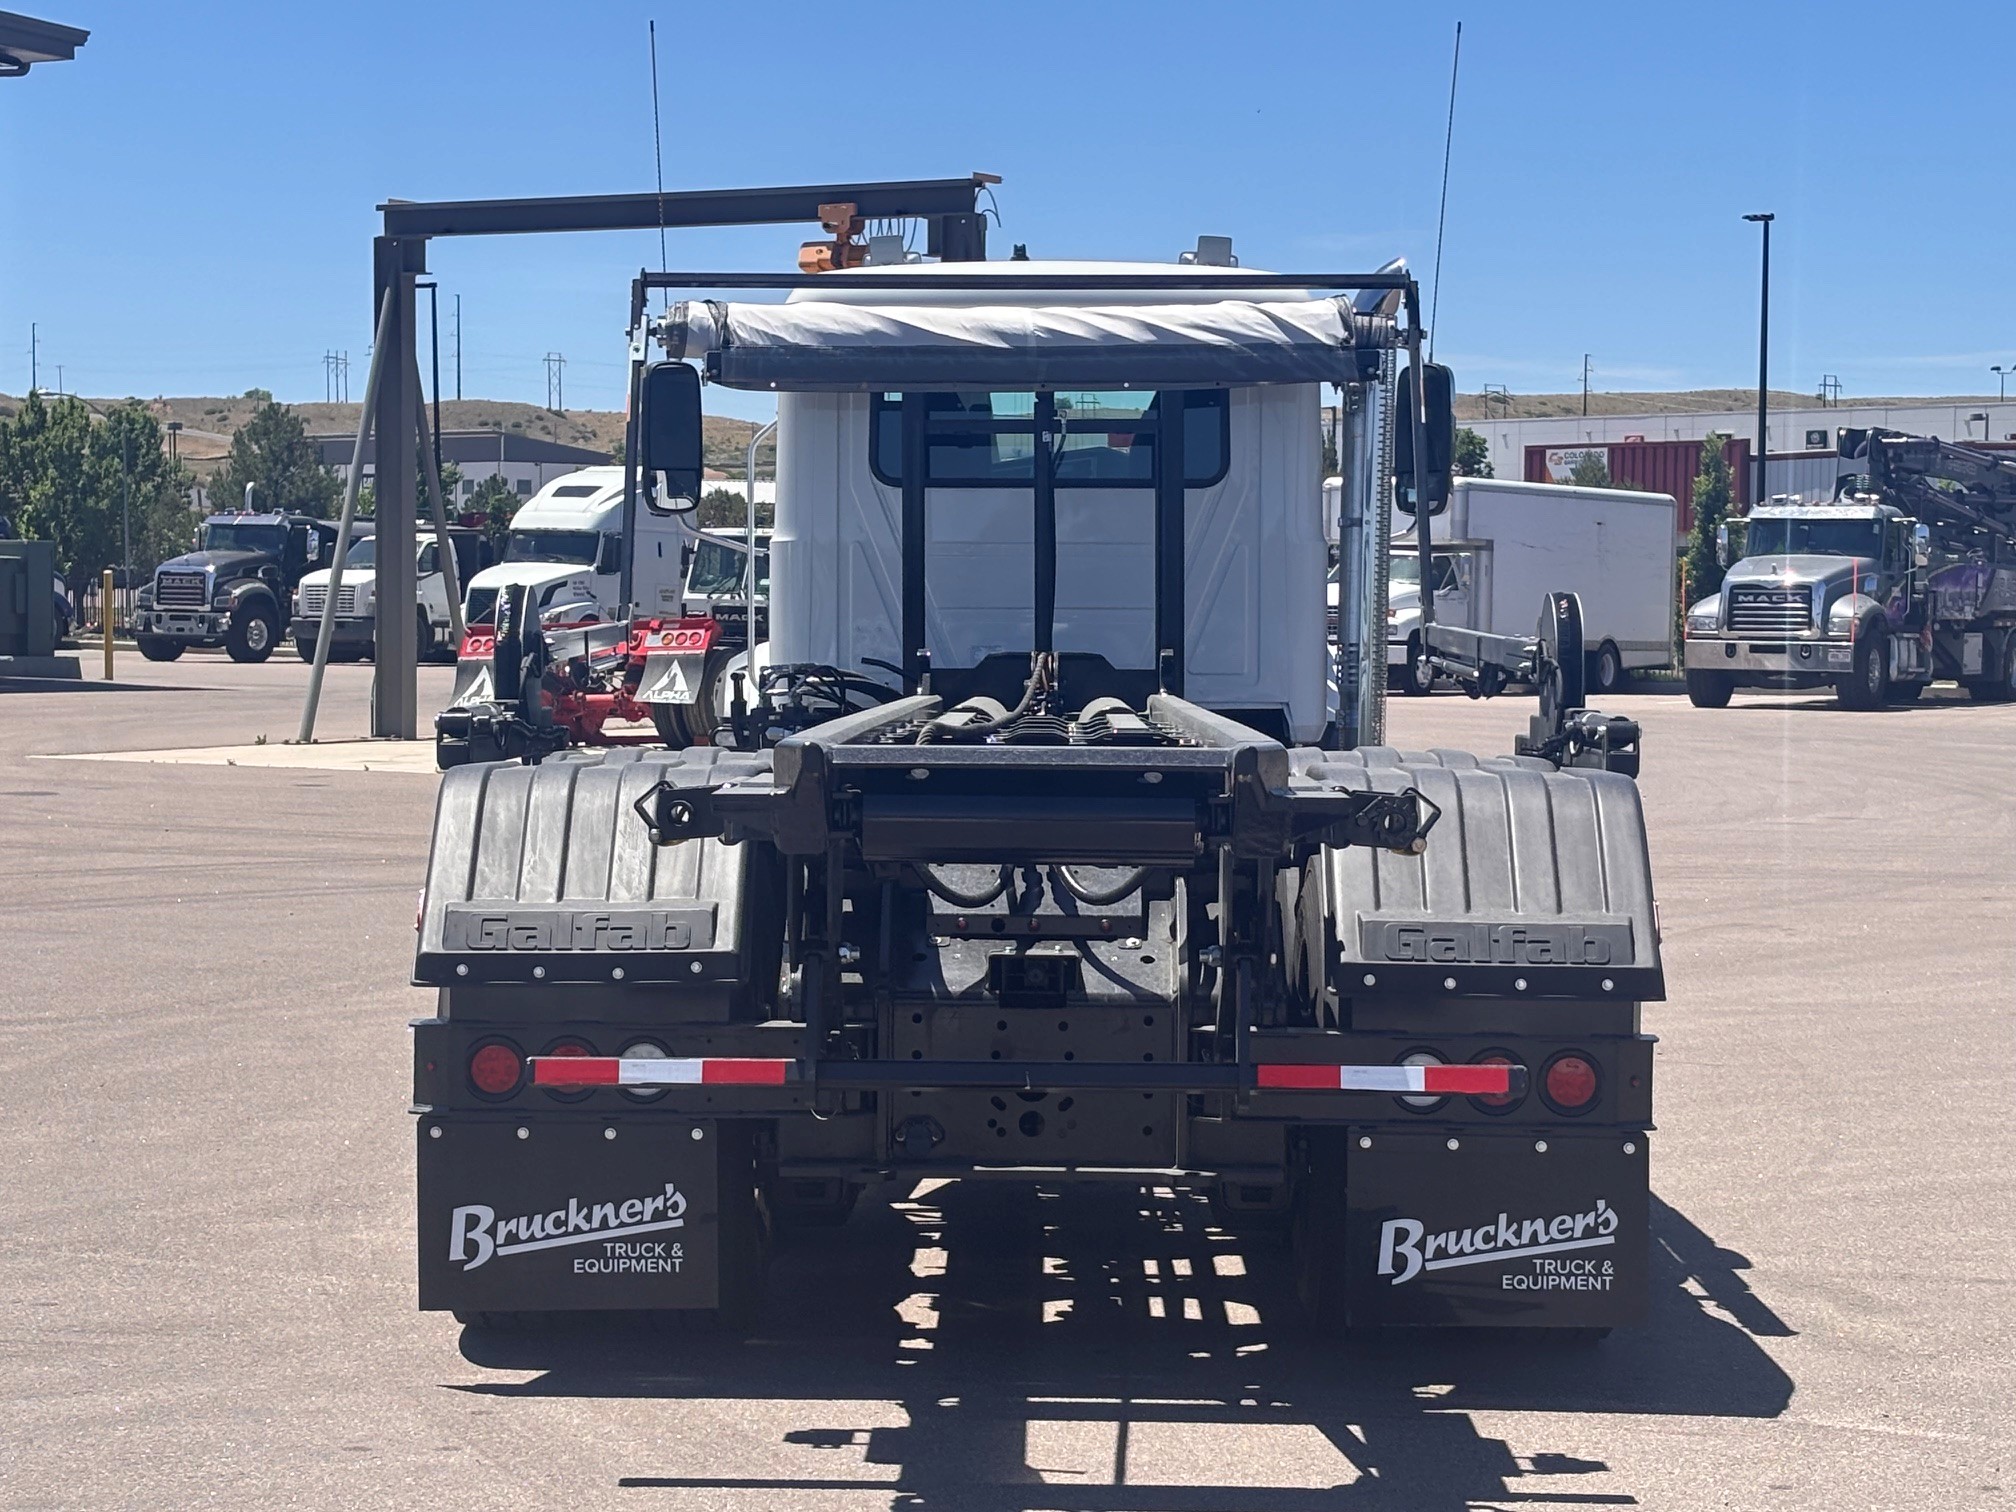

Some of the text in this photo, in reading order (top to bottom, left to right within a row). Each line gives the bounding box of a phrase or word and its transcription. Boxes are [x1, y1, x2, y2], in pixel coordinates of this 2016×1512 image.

[1564, 450, 1605, 460] COLODO
[162, 578, 201, 586] MACK
[1738, 594, 1804, 602] MACK
[642, 690, 691, 701] ALPHA
[466, 912, 692, 951] Galfab
[1384, 922, 1612, 965] Galfab
[449, 1183, 687, 1272] Bruckner's
[603, 1242, 684, 1258] TRUCK &
[1377, 1199, 1619, 1286] Bruckner's
[573, 1258, 684, 1274] EQUIPMENT
[1532, 1259, 1615, 1275] TRUCK &
[1502, 1275, 1615, 1291] EQUIPMENT
